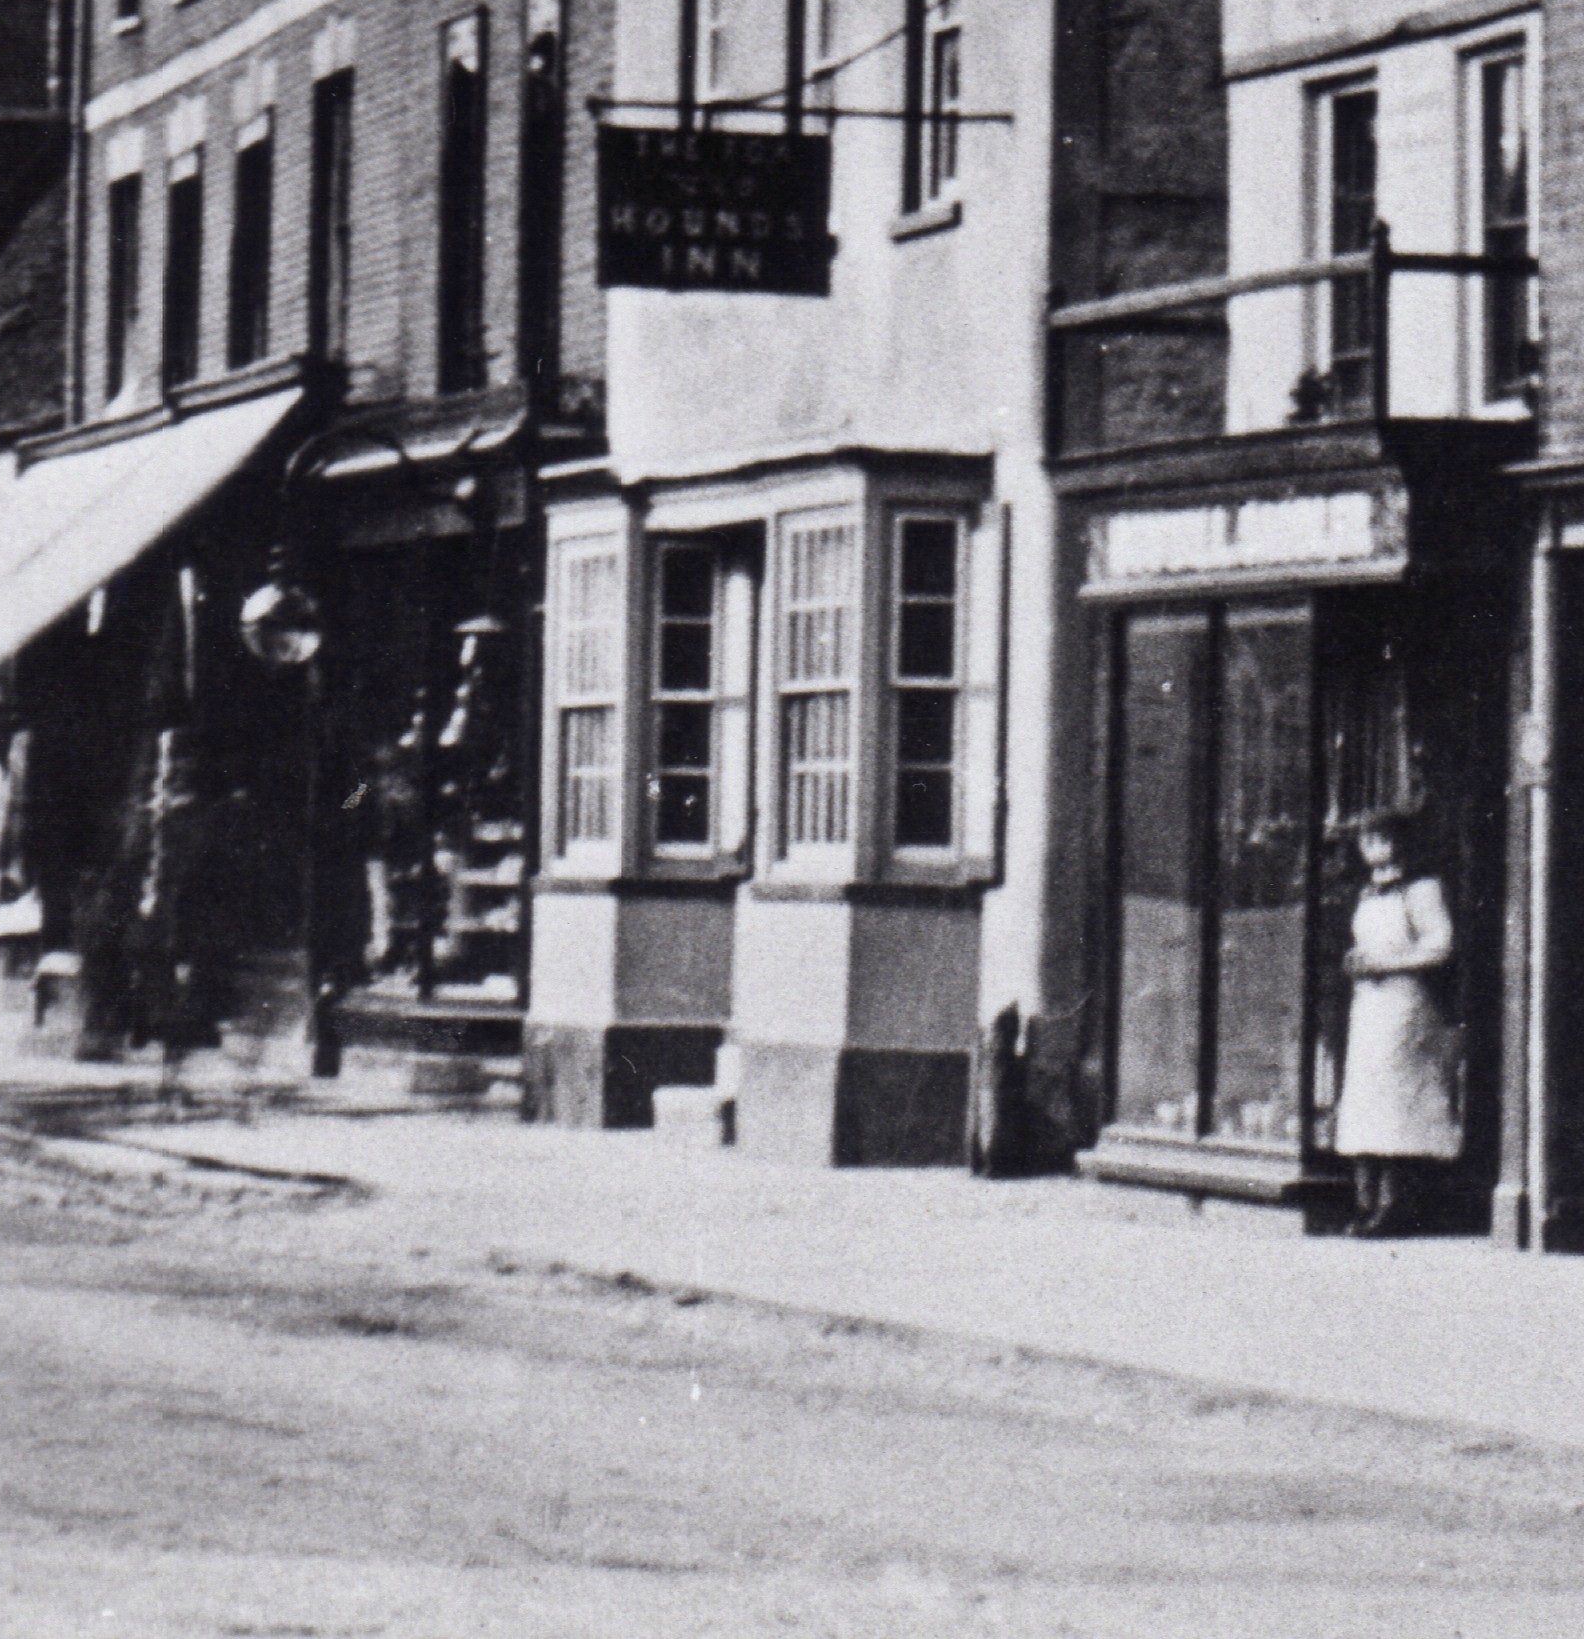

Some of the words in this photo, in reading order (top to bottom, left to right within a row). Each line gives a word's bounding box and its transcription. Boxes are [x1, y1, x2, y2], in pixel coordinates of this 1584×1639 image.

[636, 133, 699, 162] THE
[611, 203, 804, 241] HOUNDS
[662, 244, 761, 280] INN
